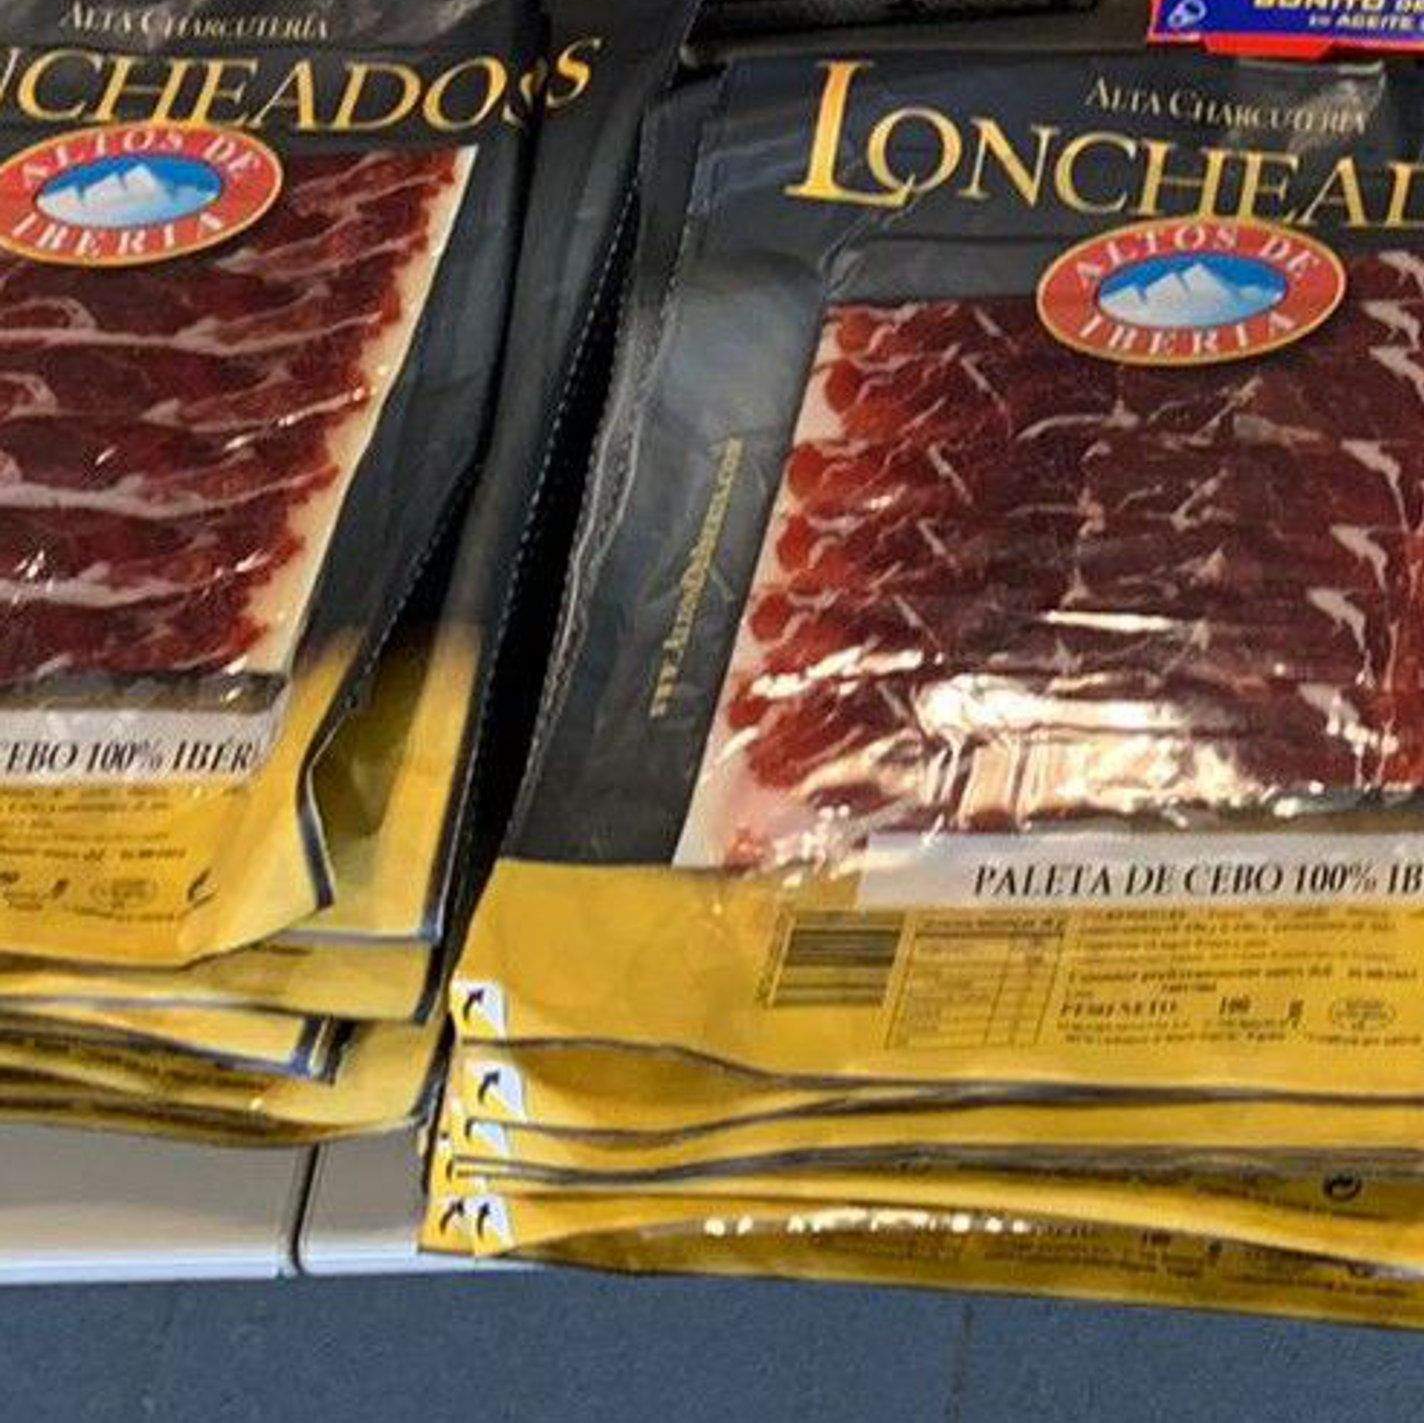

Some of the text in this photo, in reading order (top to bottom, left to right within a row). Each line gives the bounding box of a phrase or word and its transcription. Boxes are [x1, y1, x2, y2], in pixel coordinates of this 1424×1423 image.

[1336, 12, 1413, 30] ACEITE
[22, 128, 265, 191] ALTOS DE
[10, 214, 229, 257] IBERIA
[1074, 222, 1313, 286] ALTOS DE
[1078, 311, 1302, 359] IBERIA
[87, 739, 162, 772] 100%
[973, 865, 1115, 898] PALETA
[1124, 863, 1181, 896] DE
[1188, 862, 1287, 896] CEBO
[1293, 861, 1379, 894] 100%
